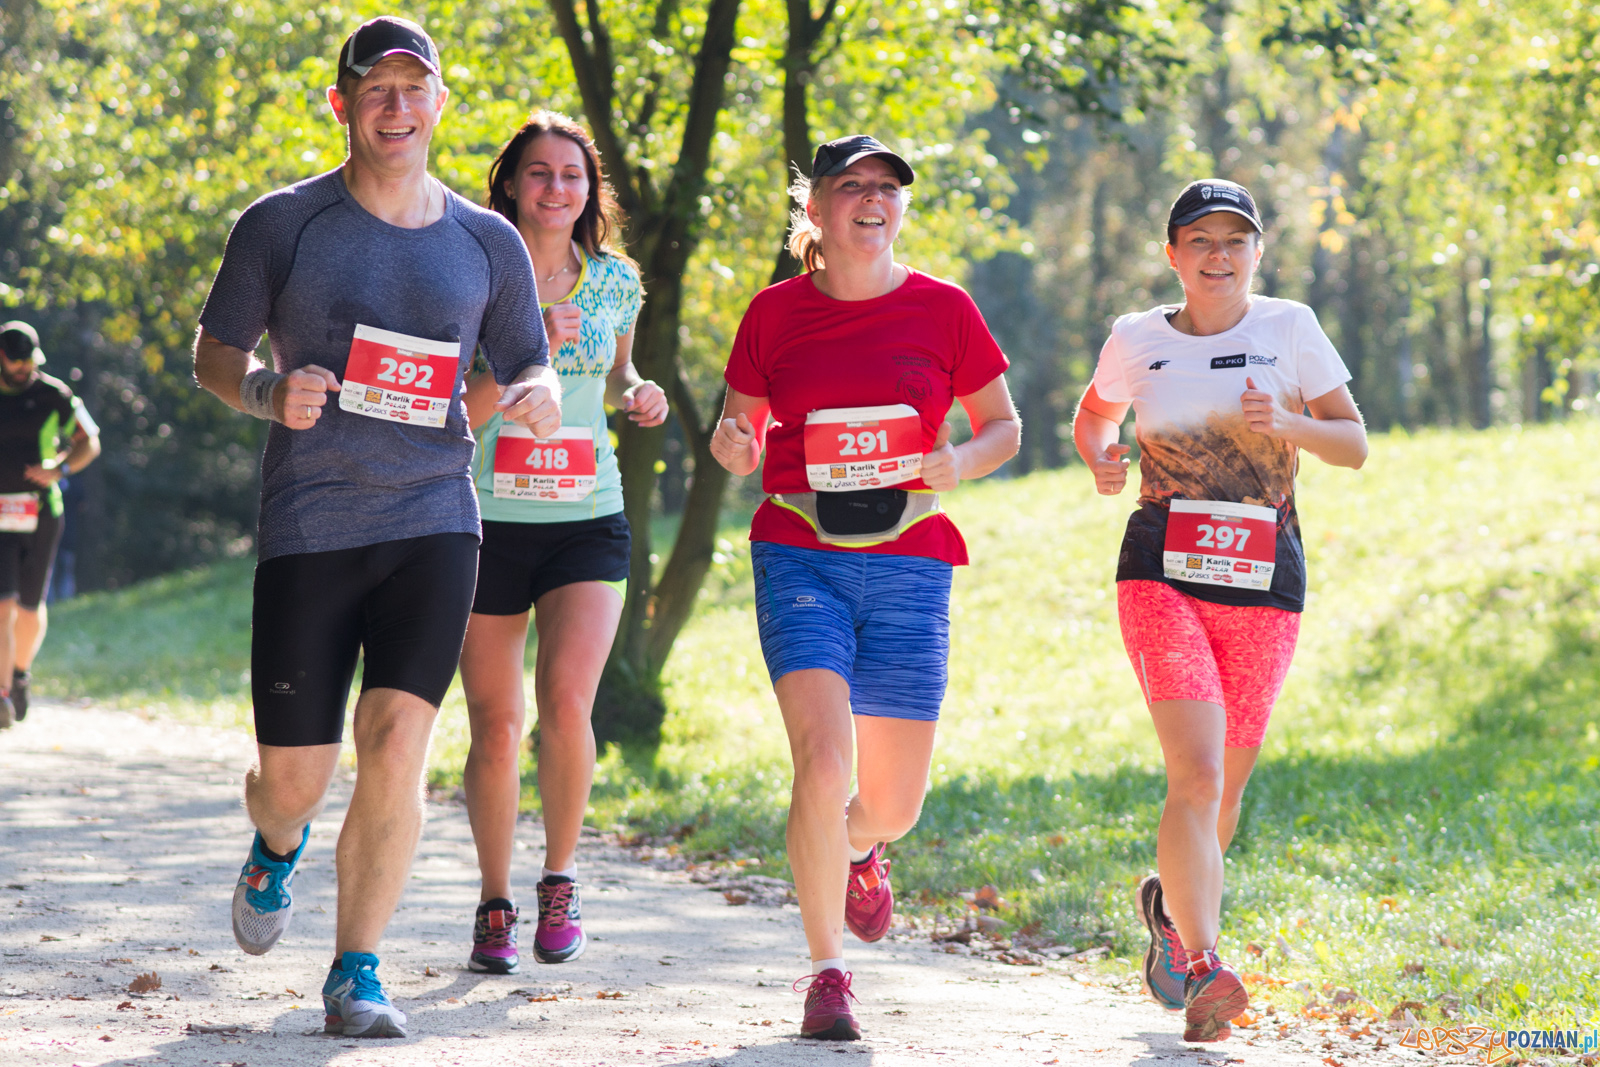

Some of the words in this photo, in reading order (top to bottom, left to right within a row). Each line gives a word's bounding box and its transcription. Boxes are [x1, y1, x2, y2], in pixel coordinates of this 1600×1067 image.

[1225, 357, 1244, 366] PKO
[376, 357, 434, 390] 292
[385, 393, 411, 404] Karlik
[372, 406, 387, 415] asics
[837, 430, 888, 456] 291
[525, 447, 569, 470] 418
[850, 464, 876, 472] Karlik
[841, 480, 857, 488] asics
[1195, 523, 1251, 552] 297
[1206, 558, 1231, 567] Karlik
